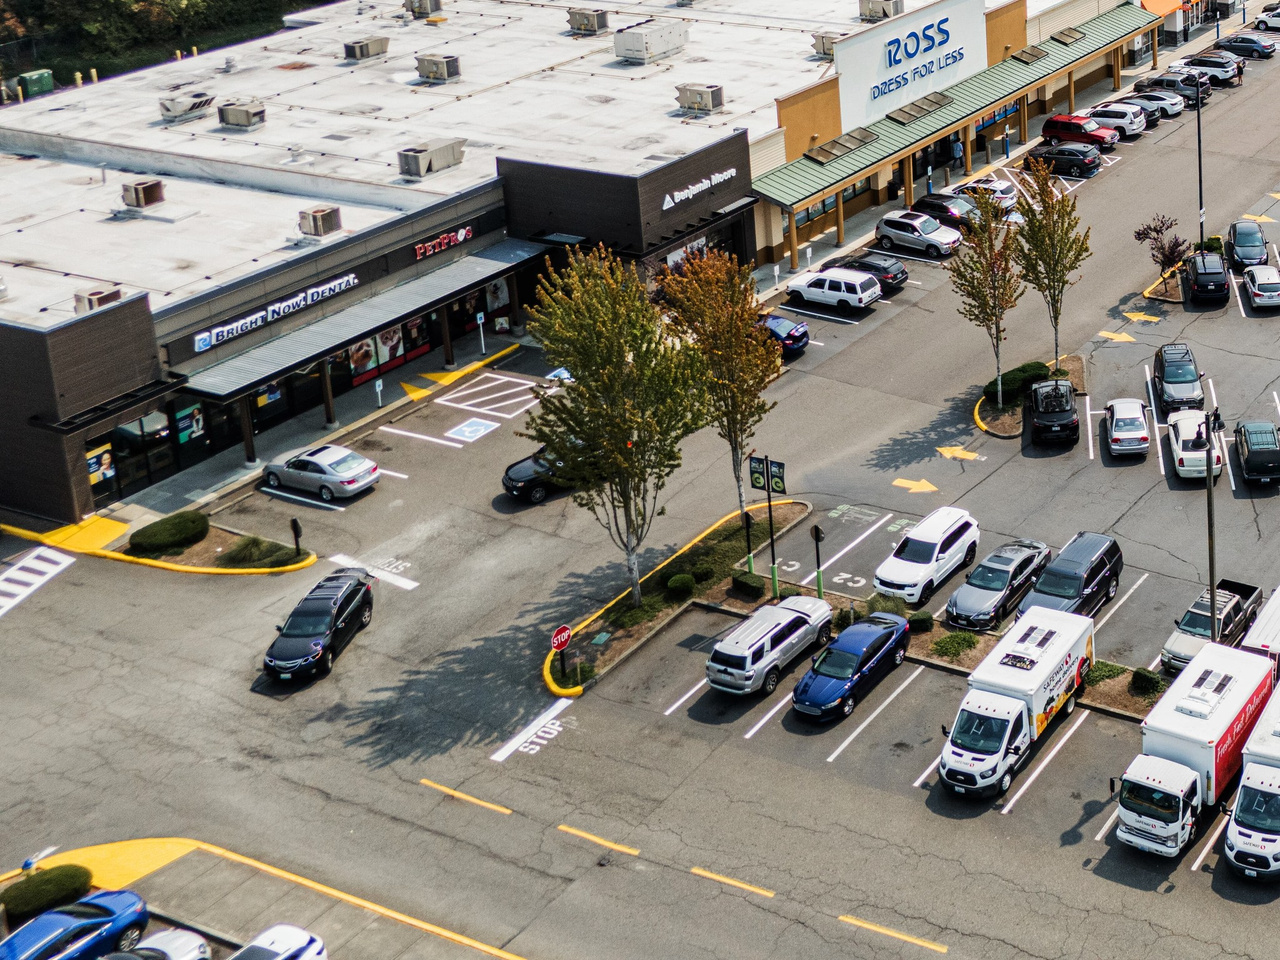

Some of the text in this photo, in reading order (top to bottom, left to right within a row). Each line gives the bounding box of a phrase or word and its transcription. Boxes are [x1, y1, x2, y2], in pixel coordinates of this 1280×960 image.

[885, 16, 950, 68] ROSS
[871, 46, 965, 100] DRESS FOR LESS
[673, 168, 737, 203] Benjamin Moore
[832, 572, 867, 587] C2
[553, 630, 570, 647] STOP
[518, 719, 563, 754] STOP
